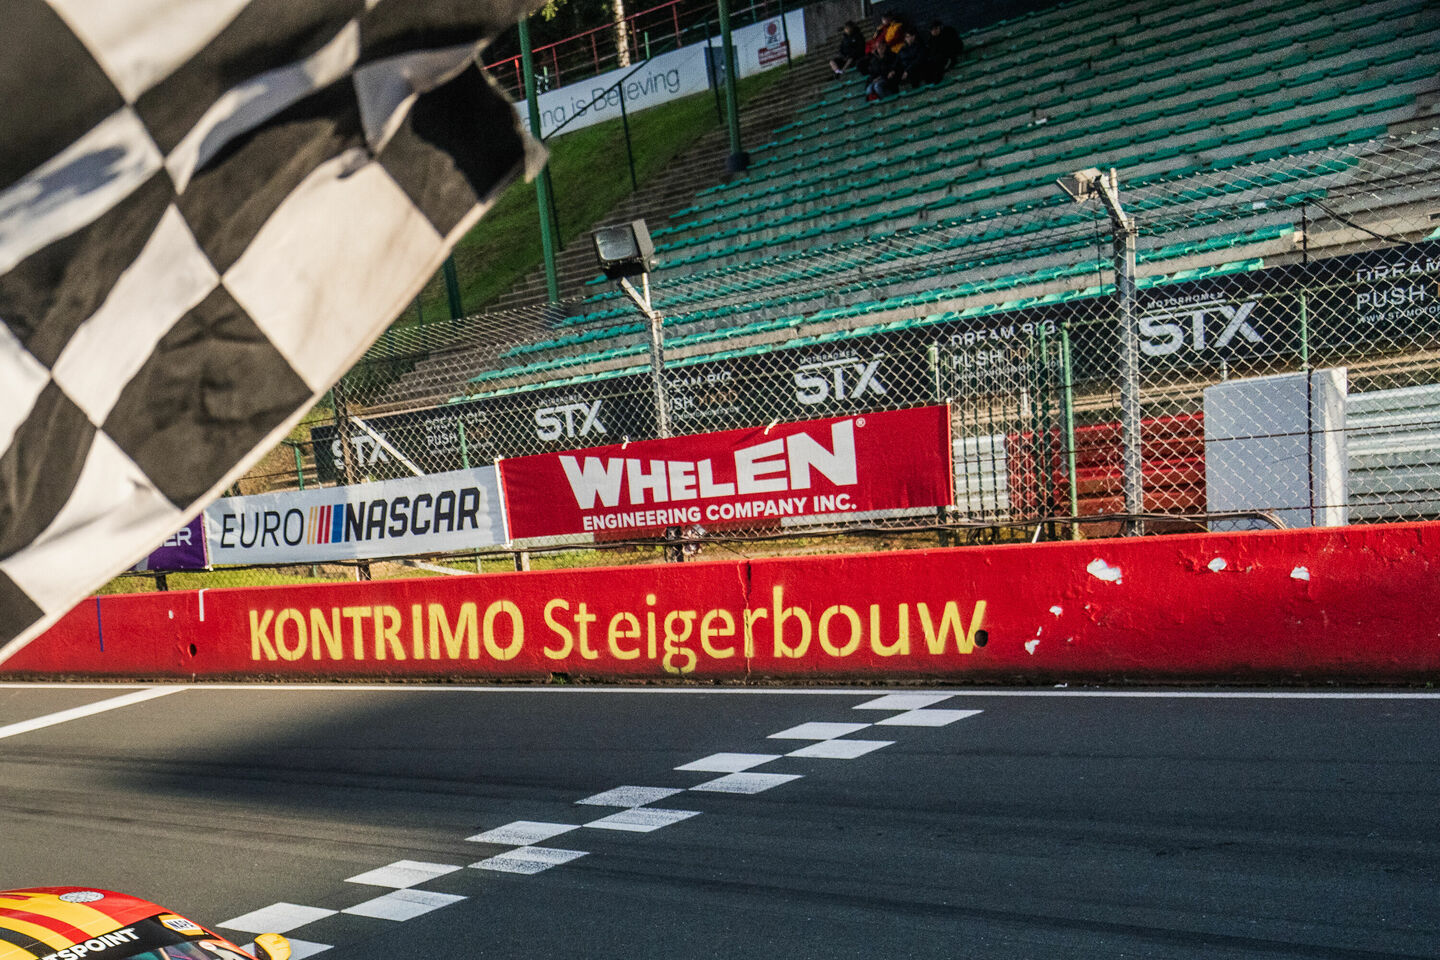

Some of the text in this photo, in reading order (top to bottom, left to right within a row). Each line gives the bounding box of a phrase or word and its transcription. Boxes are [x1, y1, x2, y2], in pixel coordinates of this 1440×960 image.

[1139, 293, 1262, 356] STX
[1357, 284, 1425, 310] PUSH
[795, 353, 886, 405] STX
[535, 400, 607, 441] STX
[559, 418, 859, 510] WHELEN
[221, 487, 480, 549] EURO NASCAR
[583, 493, 857, 532] ENGINEERING COMPANY INC.
[249, 584, 988, 675] KONTRIMO Steigerbouw
